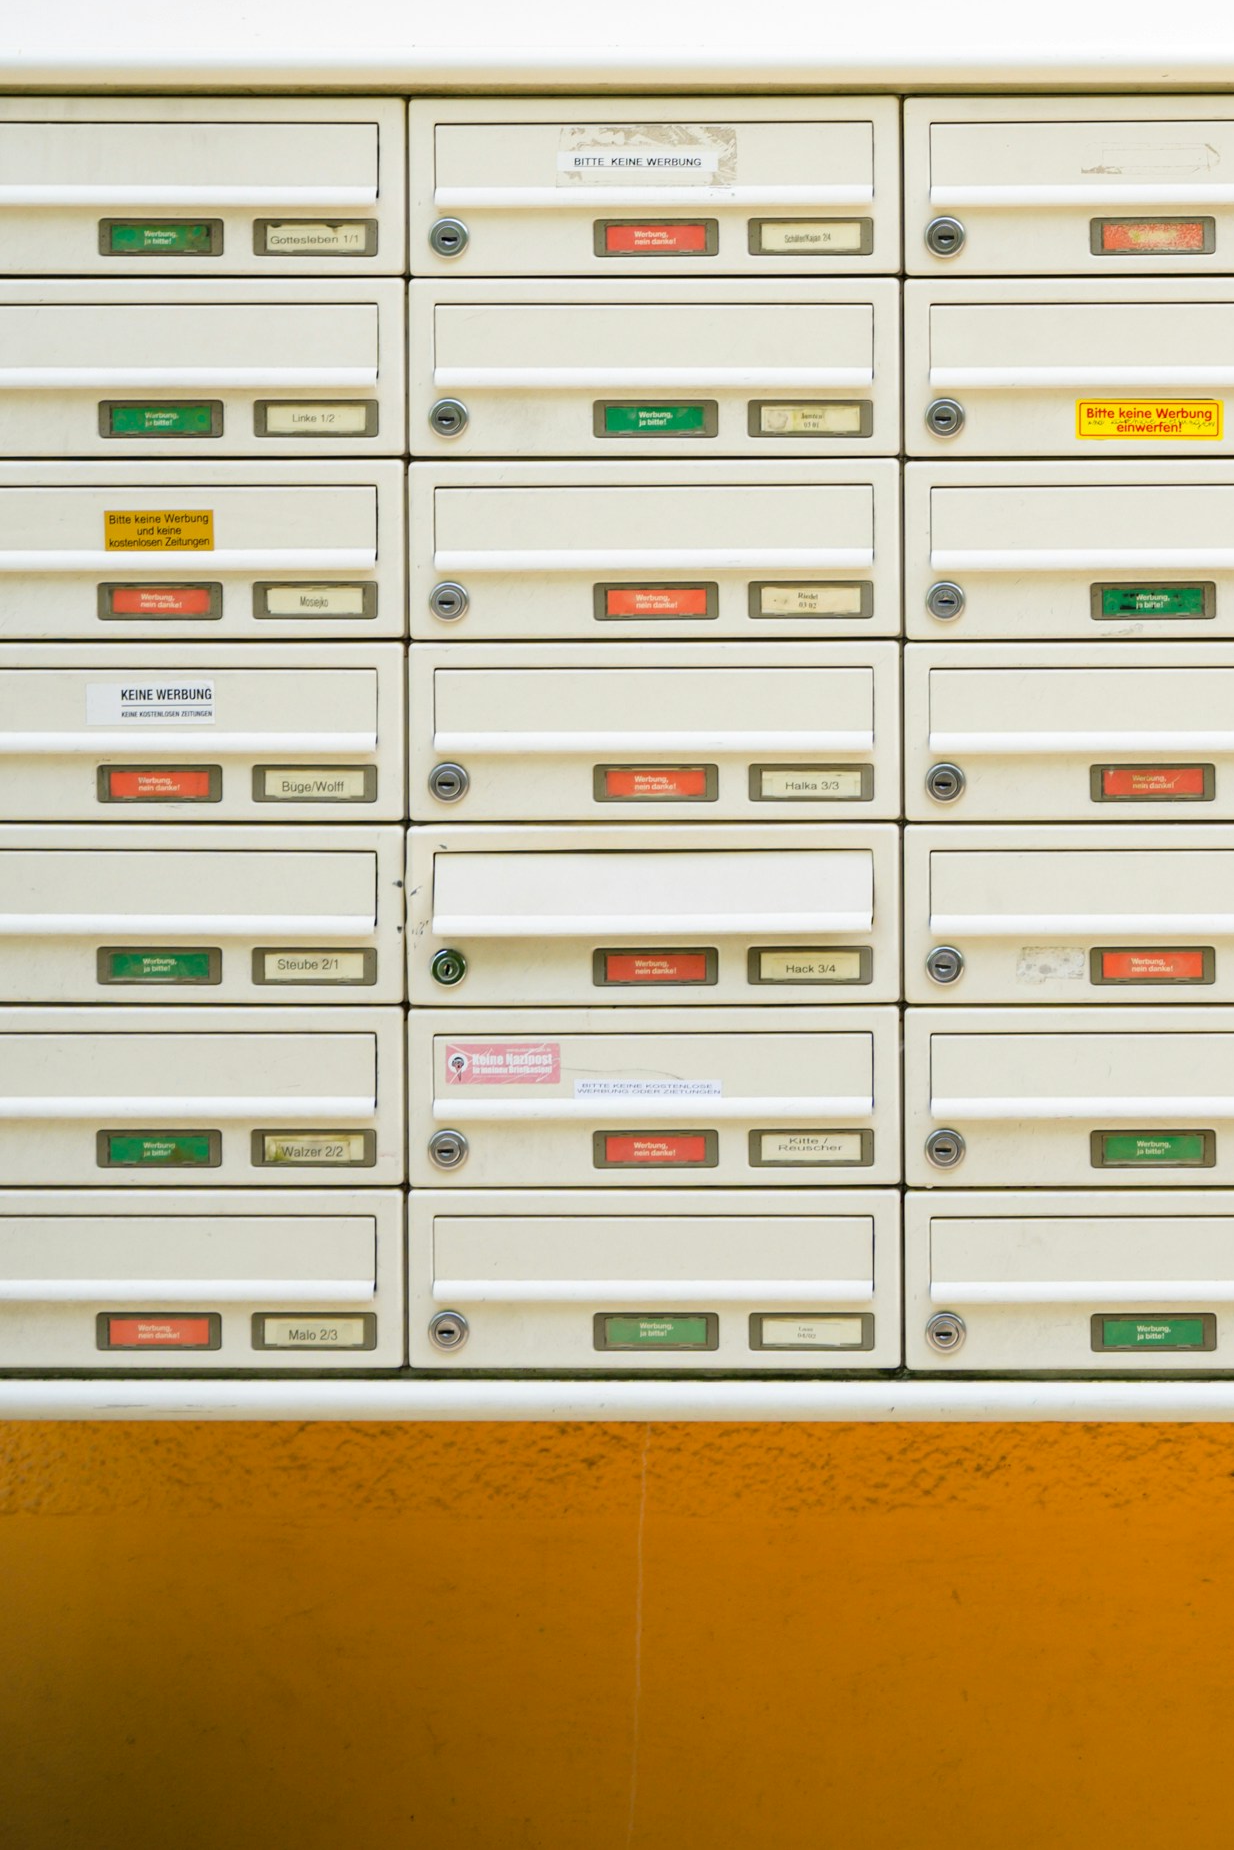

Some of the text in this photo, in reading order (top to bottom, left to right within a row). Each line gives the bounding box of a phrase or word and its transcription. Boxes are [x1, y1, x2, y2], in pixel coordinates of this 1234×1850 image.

[574, 158, 701, 166] BITTE KEINE WERBUNG
[635, 231, 669, 239] Werbung,
[271, 235, 359, 245] Gottesleben 1/1
[292, 414, 335, 423] Linke 1/2
[639, 411, 673, 419] Werbung,
[1087, 408, 1212, 420] Bitte keine Werbung
[639, 419, 646, 427] ja
[1117, 422, 1182, 432] einwerfen!
[109, 514, 208, 524] Bitte keine Werbung
[137, 526, 181, 535] und keine
[109, 537, 209, 548] kostenlosen Zeitungen
[141, 594, 175, 602] Werbung,
[798, 592, 818, 600] Riedel
[300, 596, 328, 609] Mosiejko
[121, 689, 211, 700] KEINE WERBUNG
[138, 777, 172, 785] Werbung,
[282, 781, 344, 794] Büge/Wolff
[785, 782, 839, 790] Halka 3/3
[278, 959, 339, 970] Steube 2/1
[1131, 958, 1165, 966] Werbung,
[786, 965, 836, 973] Hack 3/4
[282, 1146, 343, 1157] Walzer 2/2
[1137, 1325, 1171, 1333] Werbung,
[289, 1330, 338, 1340] Malo 2/3
[1137, 1333, 1144, 1341] ja
